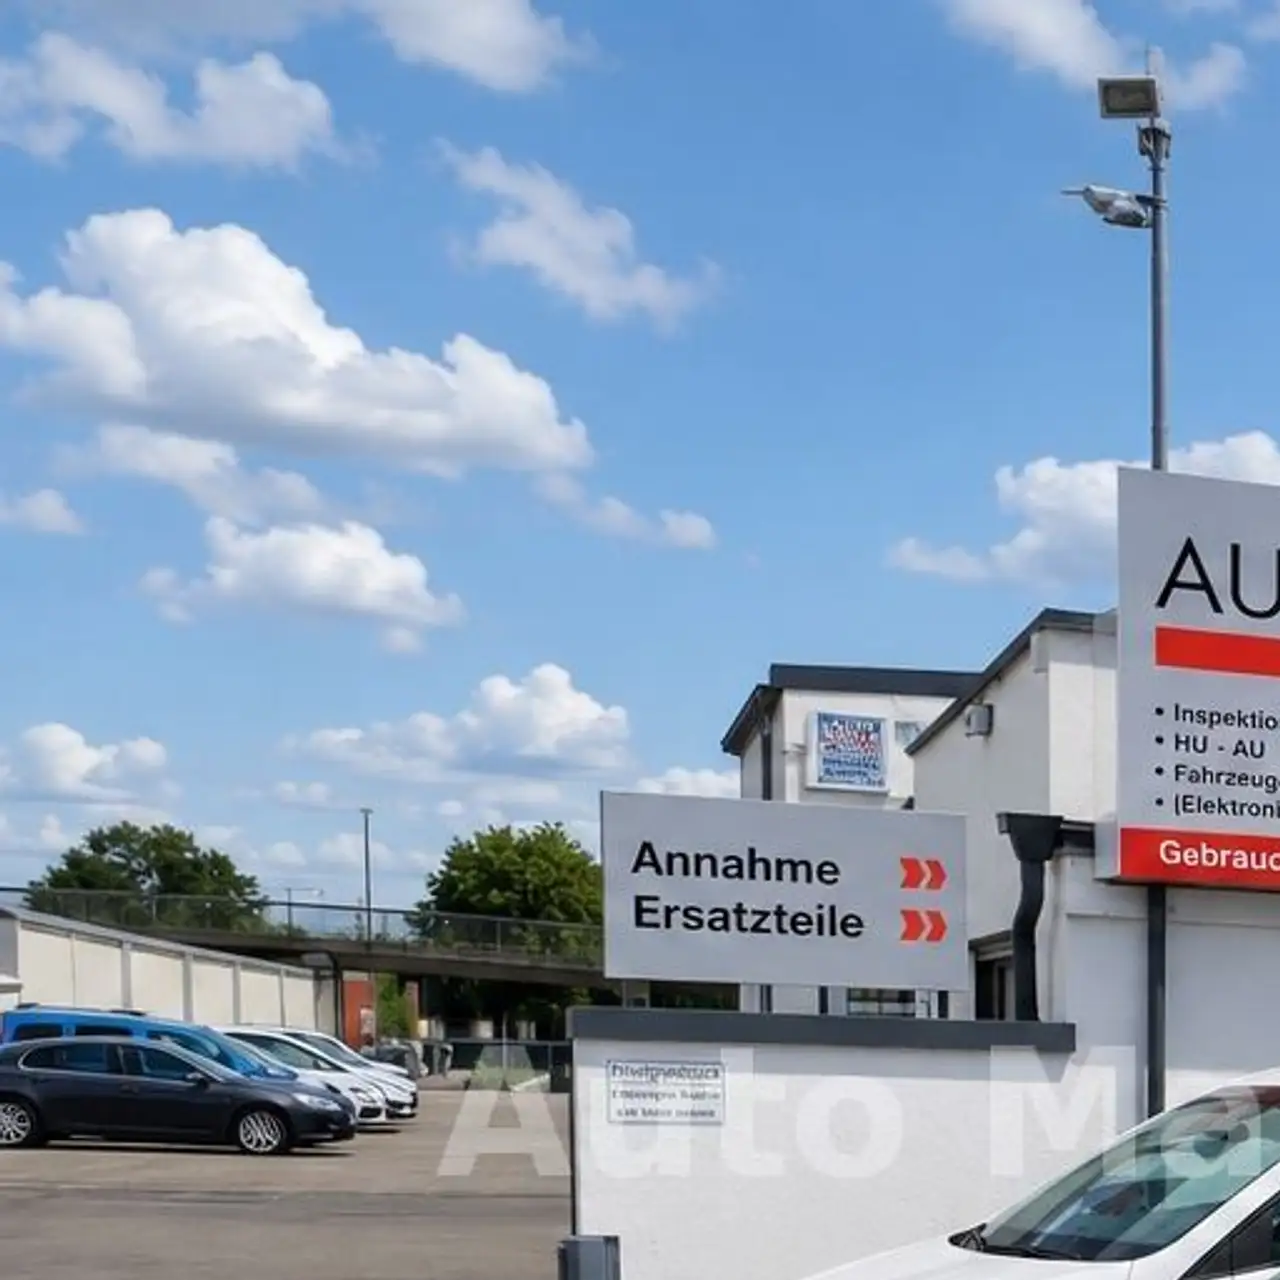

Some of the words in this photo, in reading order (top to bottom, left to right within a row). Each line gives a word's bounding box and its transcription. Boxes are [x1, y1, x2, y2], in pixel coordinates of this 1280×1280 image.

[1174, 734, 1208, 754] HU
[1232, 739, 1265, 759] AU
[631, 840, 841, 886] Annahme
[634, 894, 864, 938] Ersatzteile
